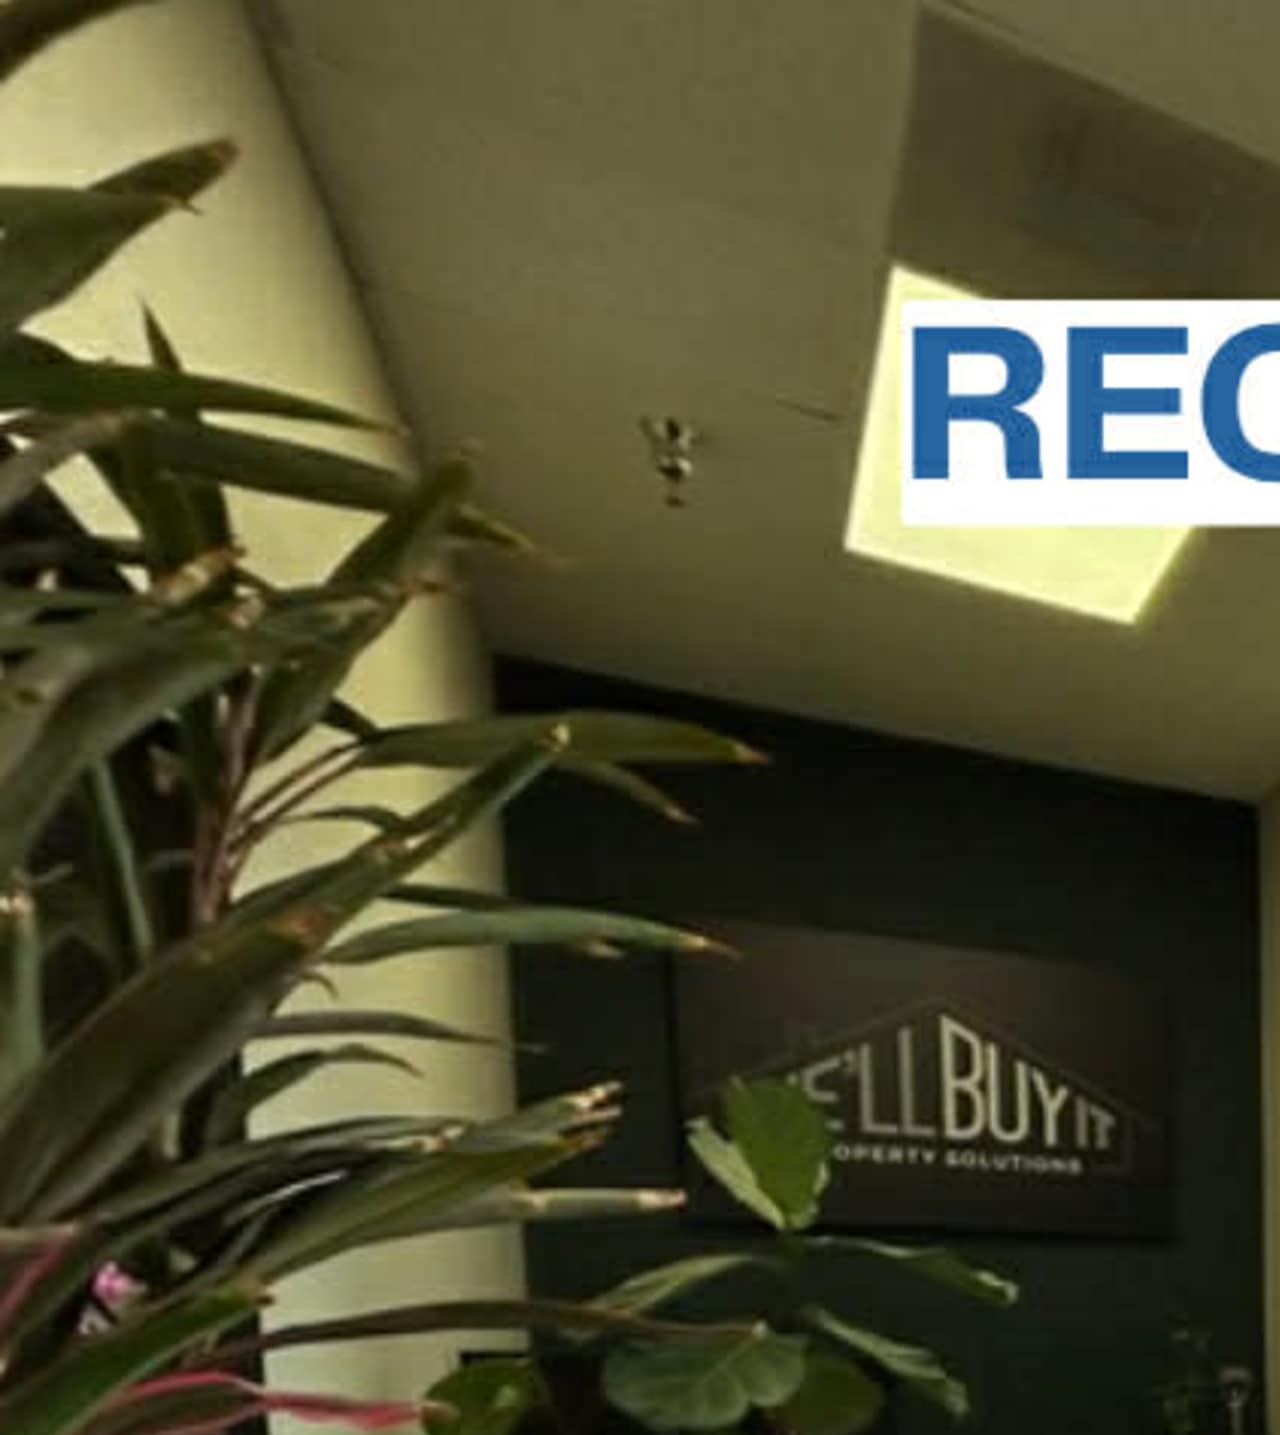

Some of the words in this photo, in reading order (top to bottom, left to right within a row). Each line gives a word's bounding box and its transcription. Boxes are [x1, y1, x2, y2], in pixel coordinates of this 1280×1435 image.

[788, 1026, 936, 1136] E'LL
[937, 1013, 1069, 1148] BUY
[1074, 1094, 1117, 1150] IT
[831, 1143, 937, 1165] OPERTY
[944, 1148, 1084, 1176] SOLUTIONS
